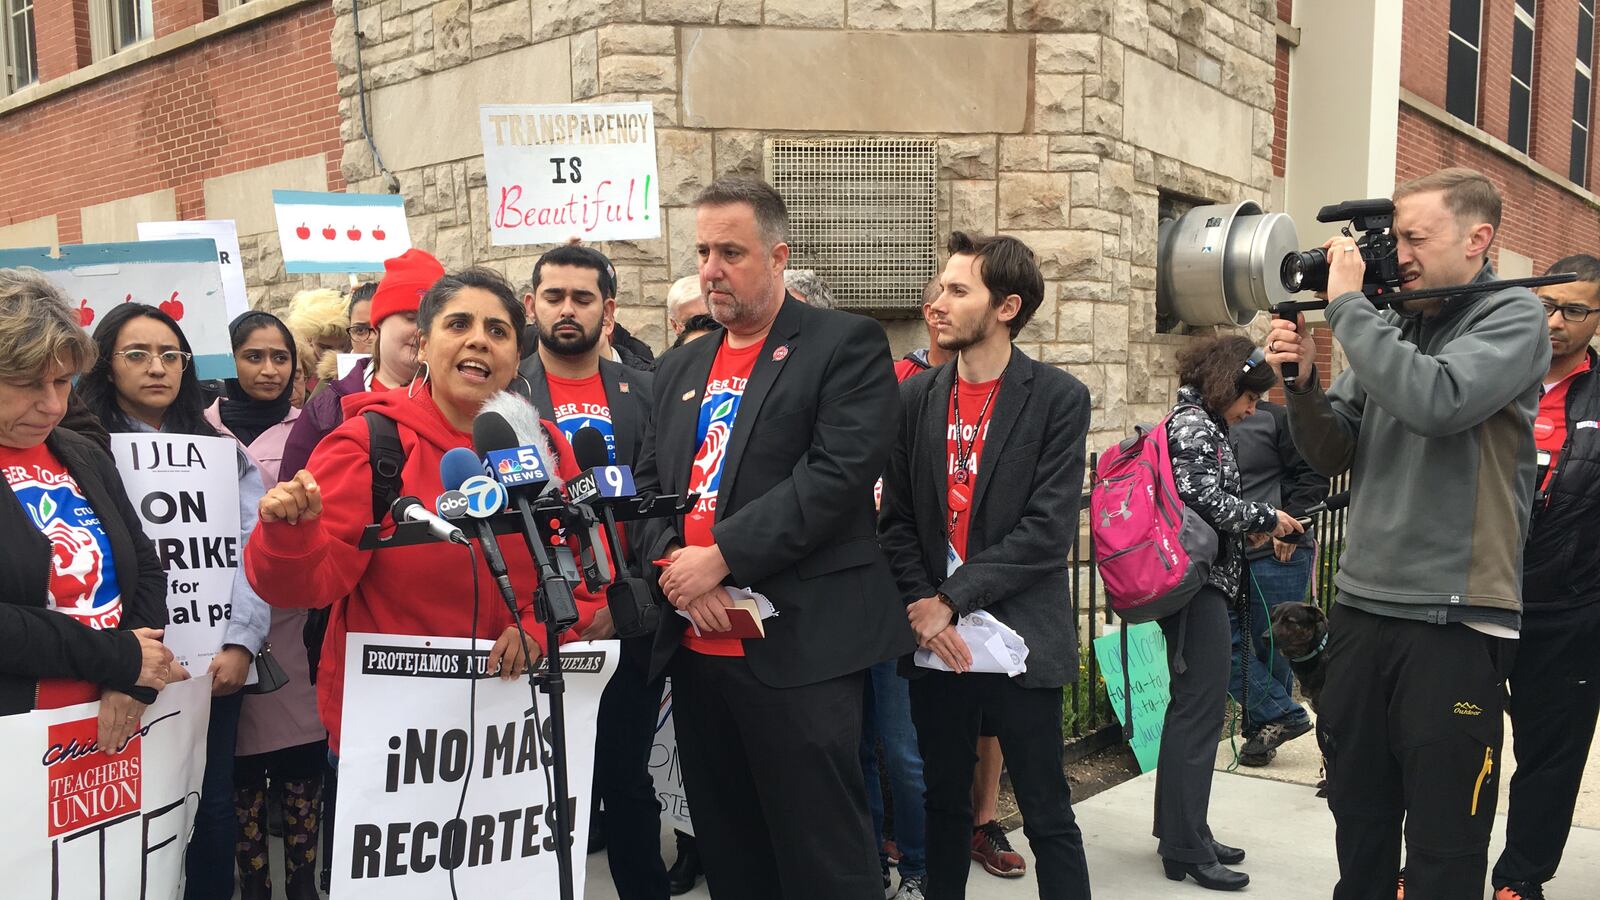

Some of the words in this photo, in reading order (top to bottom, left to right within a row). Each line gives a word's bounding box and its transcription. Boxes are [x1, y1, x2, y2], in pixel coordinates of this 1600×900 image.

[489, 114, 648, 146] TRANSPARENCY
[550, 156, 582, 184] IS
[495, 174, 651, 232] Beautiful!
[582, 403, 611, 419] TOG
[131, 441, 206, 470] IJLA
[517, 449, 540, 470] 5
[502, 470, 544, 484] NEWS
[568, 474, 596, 499] WGN
[605, 466, 623, 496] 9
[141, 491, 207, 524] ON
[440, 498, 468, 511] abc
[150, 537, 238, 570] RIKE
[171, 580, 199, 594] for
[368, 651, 459, 675] PROTEJAMOS
[385, 728, 468, 793] ¡NO
[51, 757, 140, 800] TEACHERS
[50, 778, 140, 828] UNION
